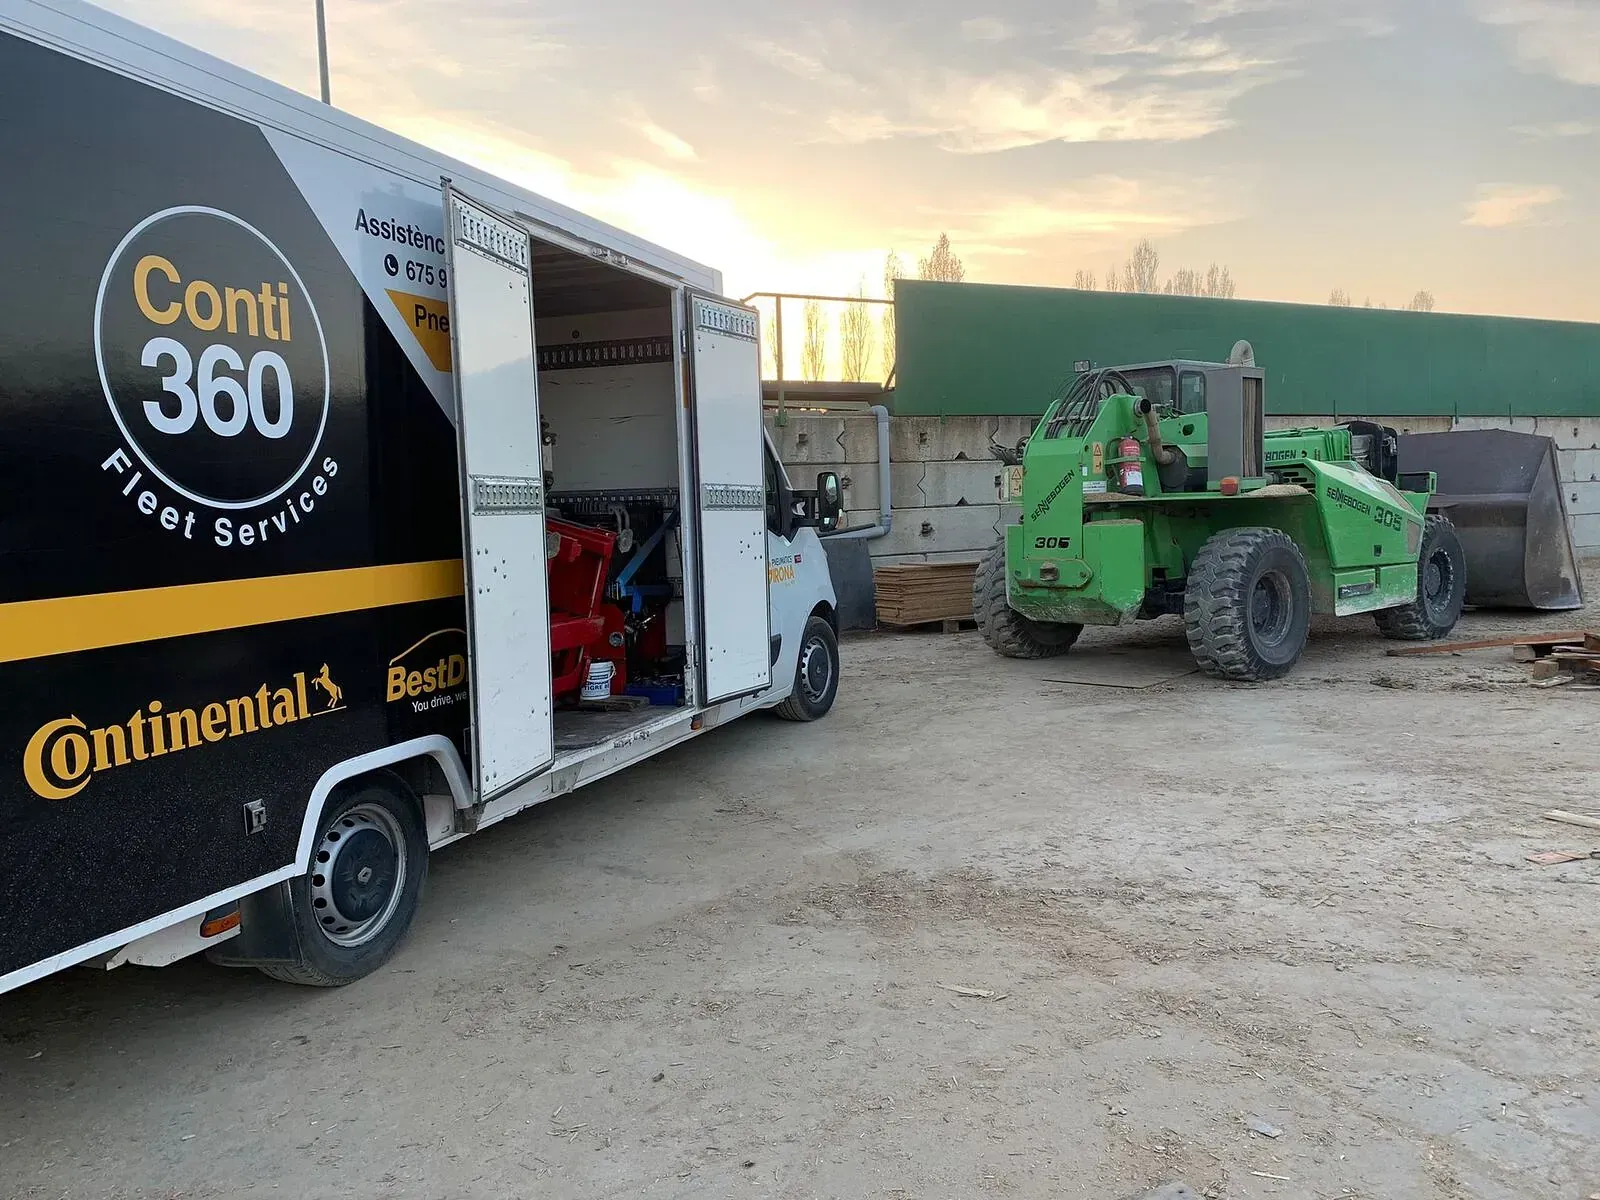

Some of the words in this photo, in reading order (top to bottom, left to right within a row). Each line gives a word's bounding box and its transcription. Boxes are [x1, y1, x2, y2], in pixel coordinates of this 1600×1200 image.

[354, 208, 445, 255] Assistènc
[406, 260, 434, 286] 675
[133, 255, 292, 341] Conti
[414, 303, 449, 333] Pne
[141, 337, 294, 439] 360
[1265, 449, 1297, 462] BOGEN
[101, 448, 195, 539] Fleet
[214, 456, 338, 546] Services
[1030, 469, 1075, 522] SENNEBOGEN
[1374, 505, 1403, 531] 305
[386, 654, 468, 703] BestD
[412, 700, 429, 713] You
[430, 695, 454, 708] drive,
[23, 672, 311, 800] Continental
